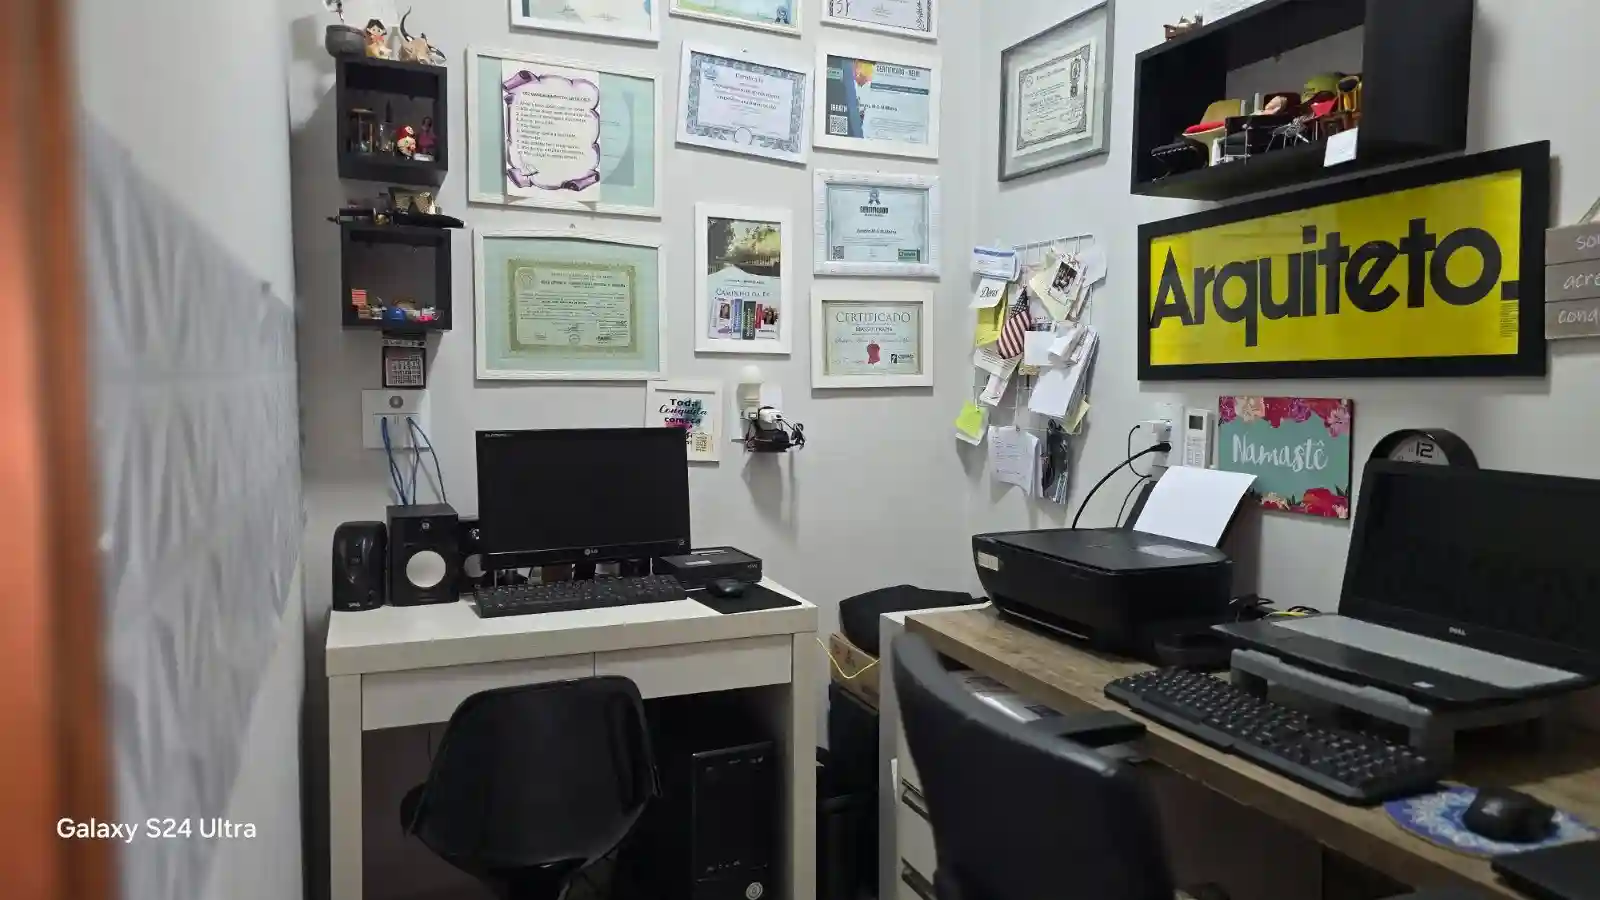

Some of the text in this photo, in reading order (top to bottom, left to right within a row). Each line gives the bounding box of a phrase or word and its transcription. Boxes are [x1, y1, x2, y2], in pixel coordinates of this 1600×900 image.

[1149, 218, 1520, 347] Arquiteto.
[836, 311, 911, 323] CERTIFICADO
[1232, 432, 1329, 472] Namastê
[1416, 441, 1433, 458] 12
